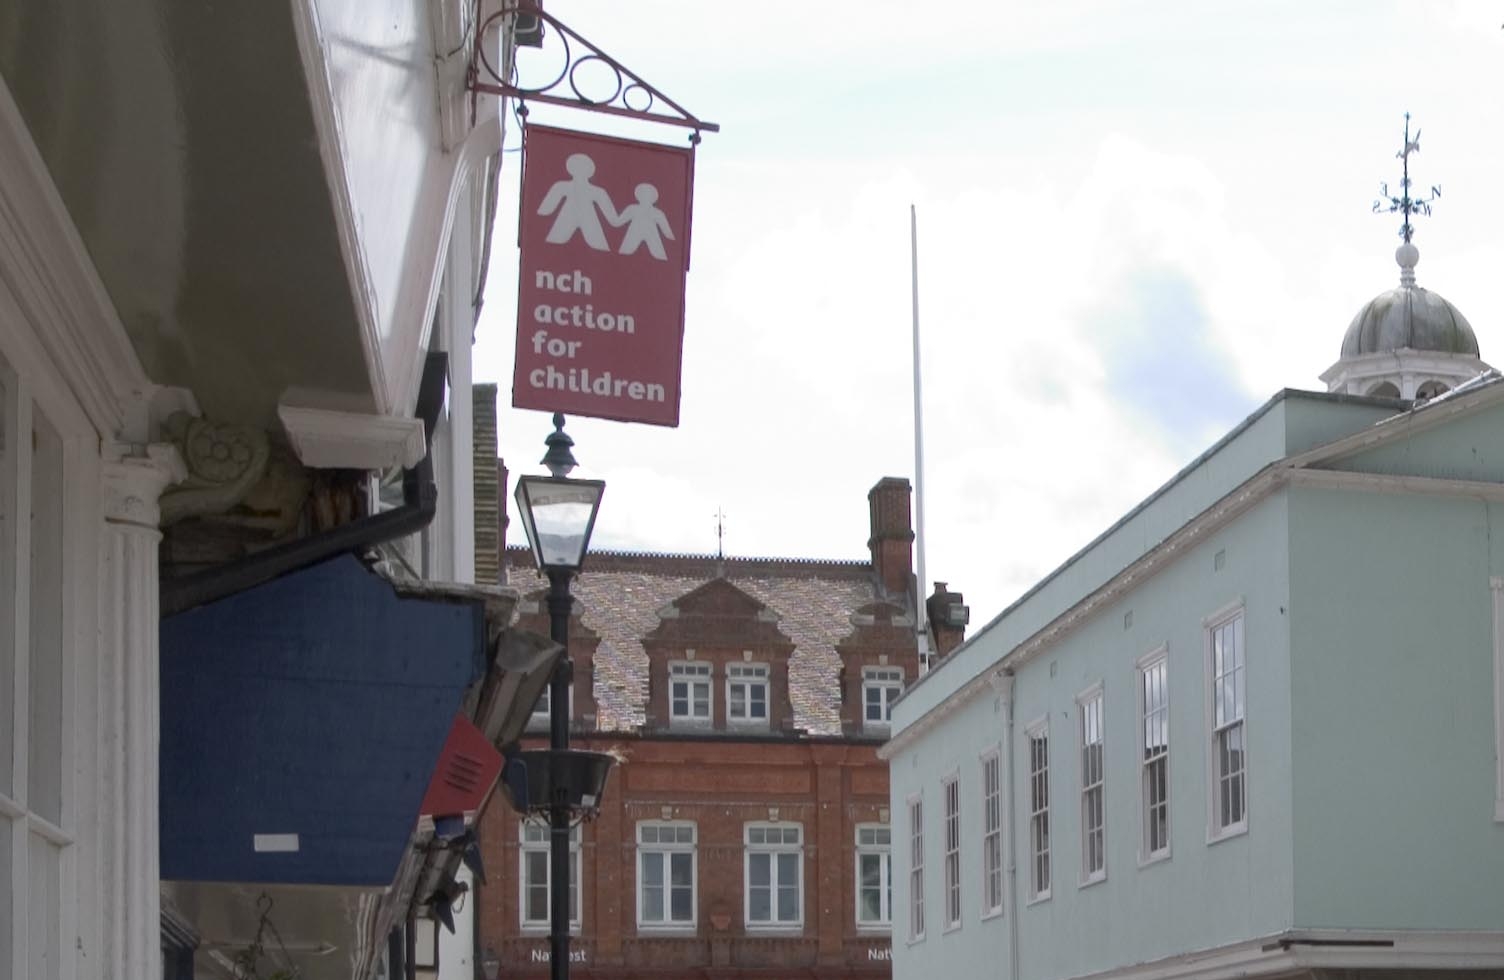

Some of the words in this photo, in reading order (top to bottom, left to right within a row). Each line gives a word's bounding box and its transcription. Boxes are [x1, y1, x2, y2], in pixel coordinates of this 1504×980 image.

[535, 270, 592, 296] nch
[533, 304, 635, 335] action
[531, 330, 582, 359] for
[529, 365, 665, 403] children
[531, 949, 587, 962] Naest
